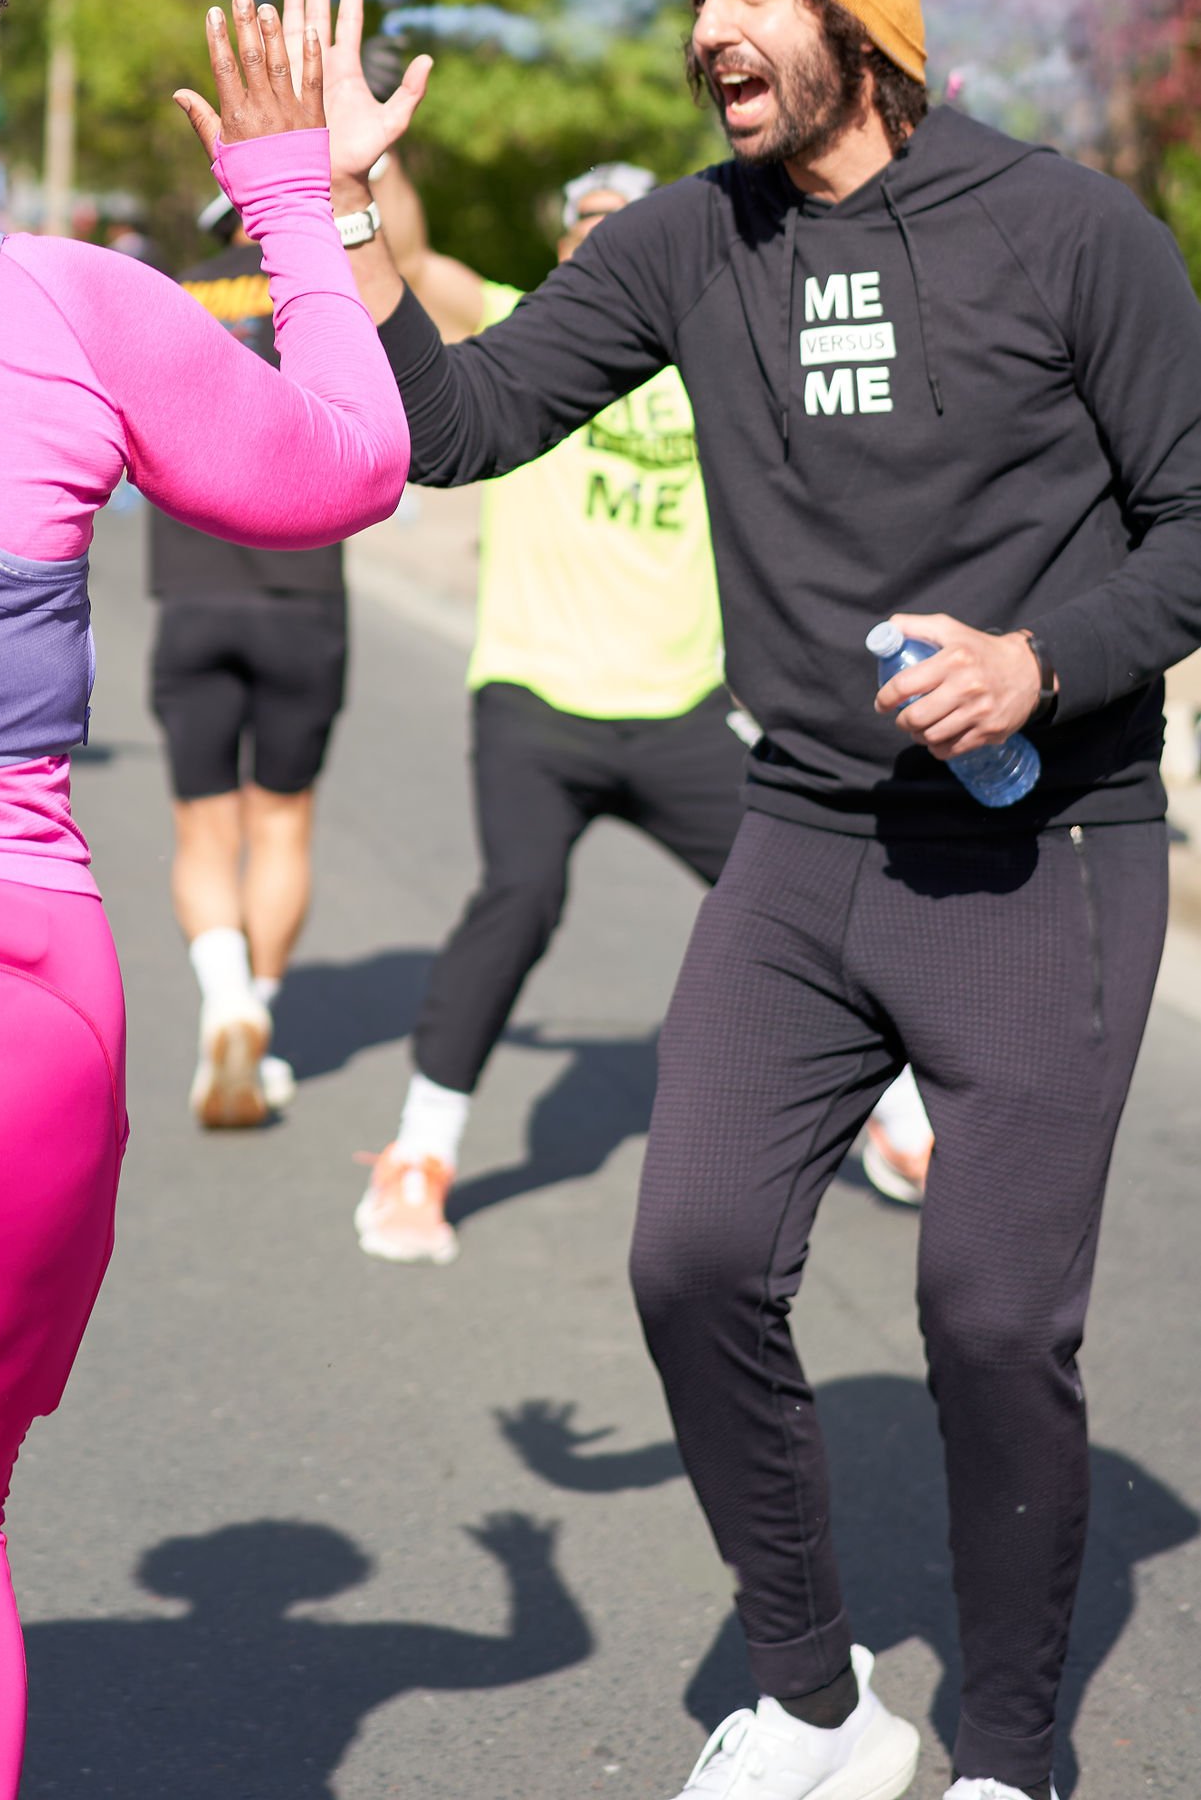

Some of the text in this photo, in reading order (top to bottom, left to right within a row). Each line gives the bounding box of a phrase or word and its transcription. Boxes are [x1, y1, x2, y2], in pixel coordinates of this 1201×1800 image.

[805, 271, 884, 323] ME
[805, 331, 886, 354] VERSUS
[804, 366, 894, 416] ME
[585, 471, 684, 529] ME
